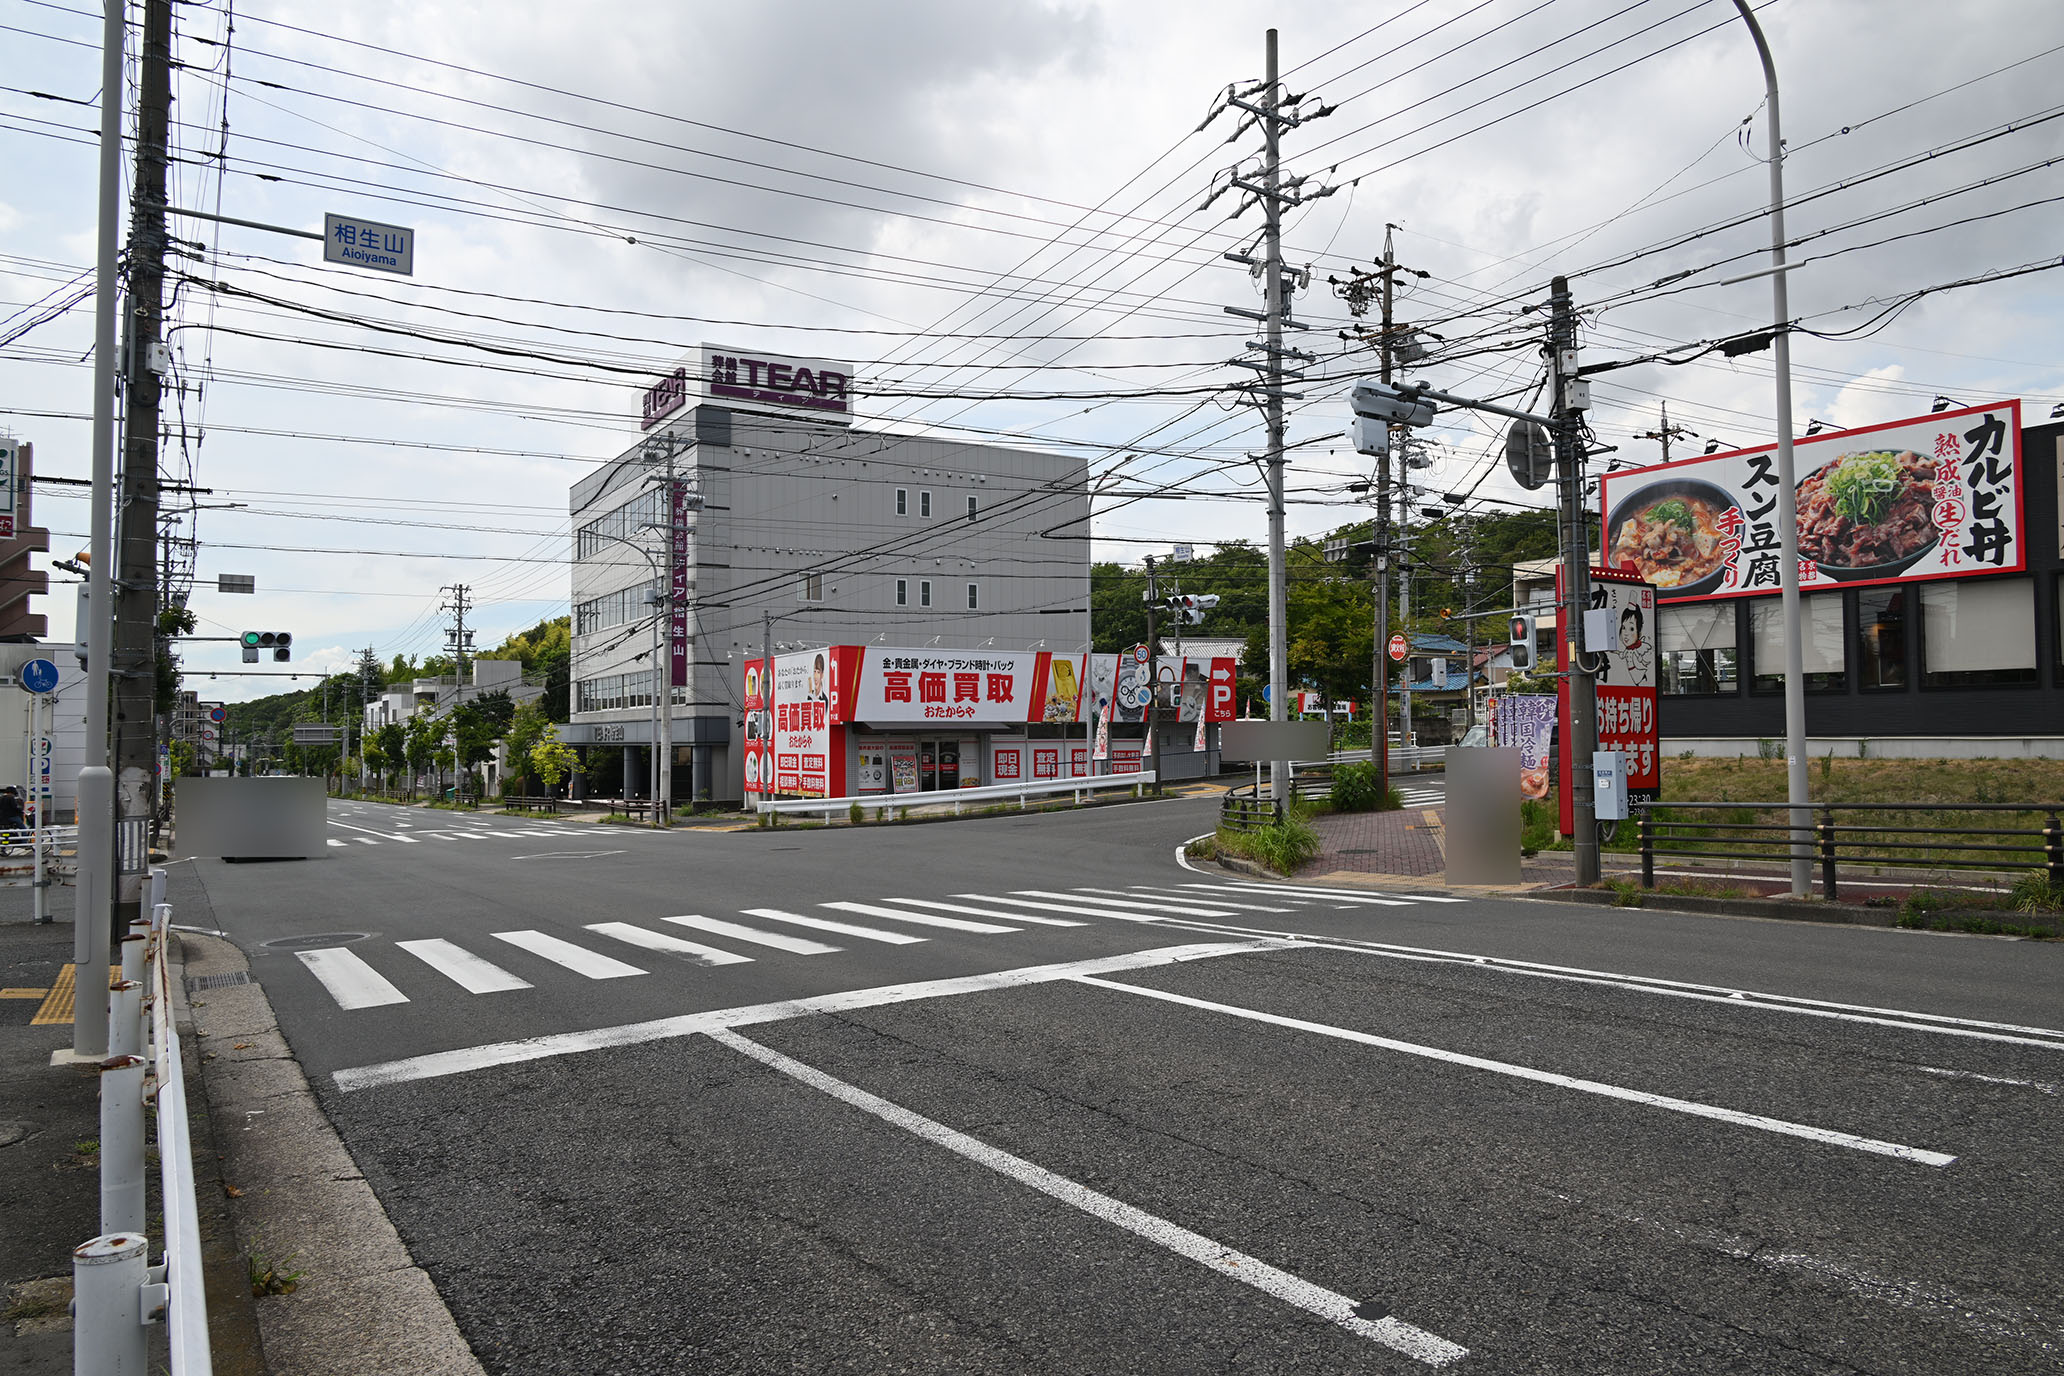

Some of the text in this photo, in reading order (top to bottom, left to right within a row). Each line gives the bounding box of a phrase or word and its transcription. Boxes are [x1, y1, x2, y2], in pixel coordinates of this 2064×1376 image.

[334, 223, 404, 254] 相生山
[342, 247, 397, 266] Aioiyama
[739, 358, 847, 400] TEAR
[1961, 413, 2013, 566] カルビ丼
[1740, 454, 1781, 590] スン豆腐
[1715, 506, 1745, 589] 手づくり
[882, 657, 1014, 671] 金・貴金属・ダイヤ・ブランド時計・バッグ
[1136, 650, 1147, 659] 50
[883, 671, 1014, 704] 高価買取
[1213, 685, 1231, 709] P
[830, 691, 838, 711] P
[777, 701, 826, 733] 高価買取
[924, 705, 976, 719] おたからや
[1214, 710, 1232, 718] こちら
[1597, 696, 1653, 735] お持ち帰り
[788, 735, 813, 749] おたからや
[997, 752, 1018, 765] 即日
[1036, 752, 1056, 763] 査定
[997, 765, 1018, 776] 現金
[1036, 764, 1056, 775] 無料
